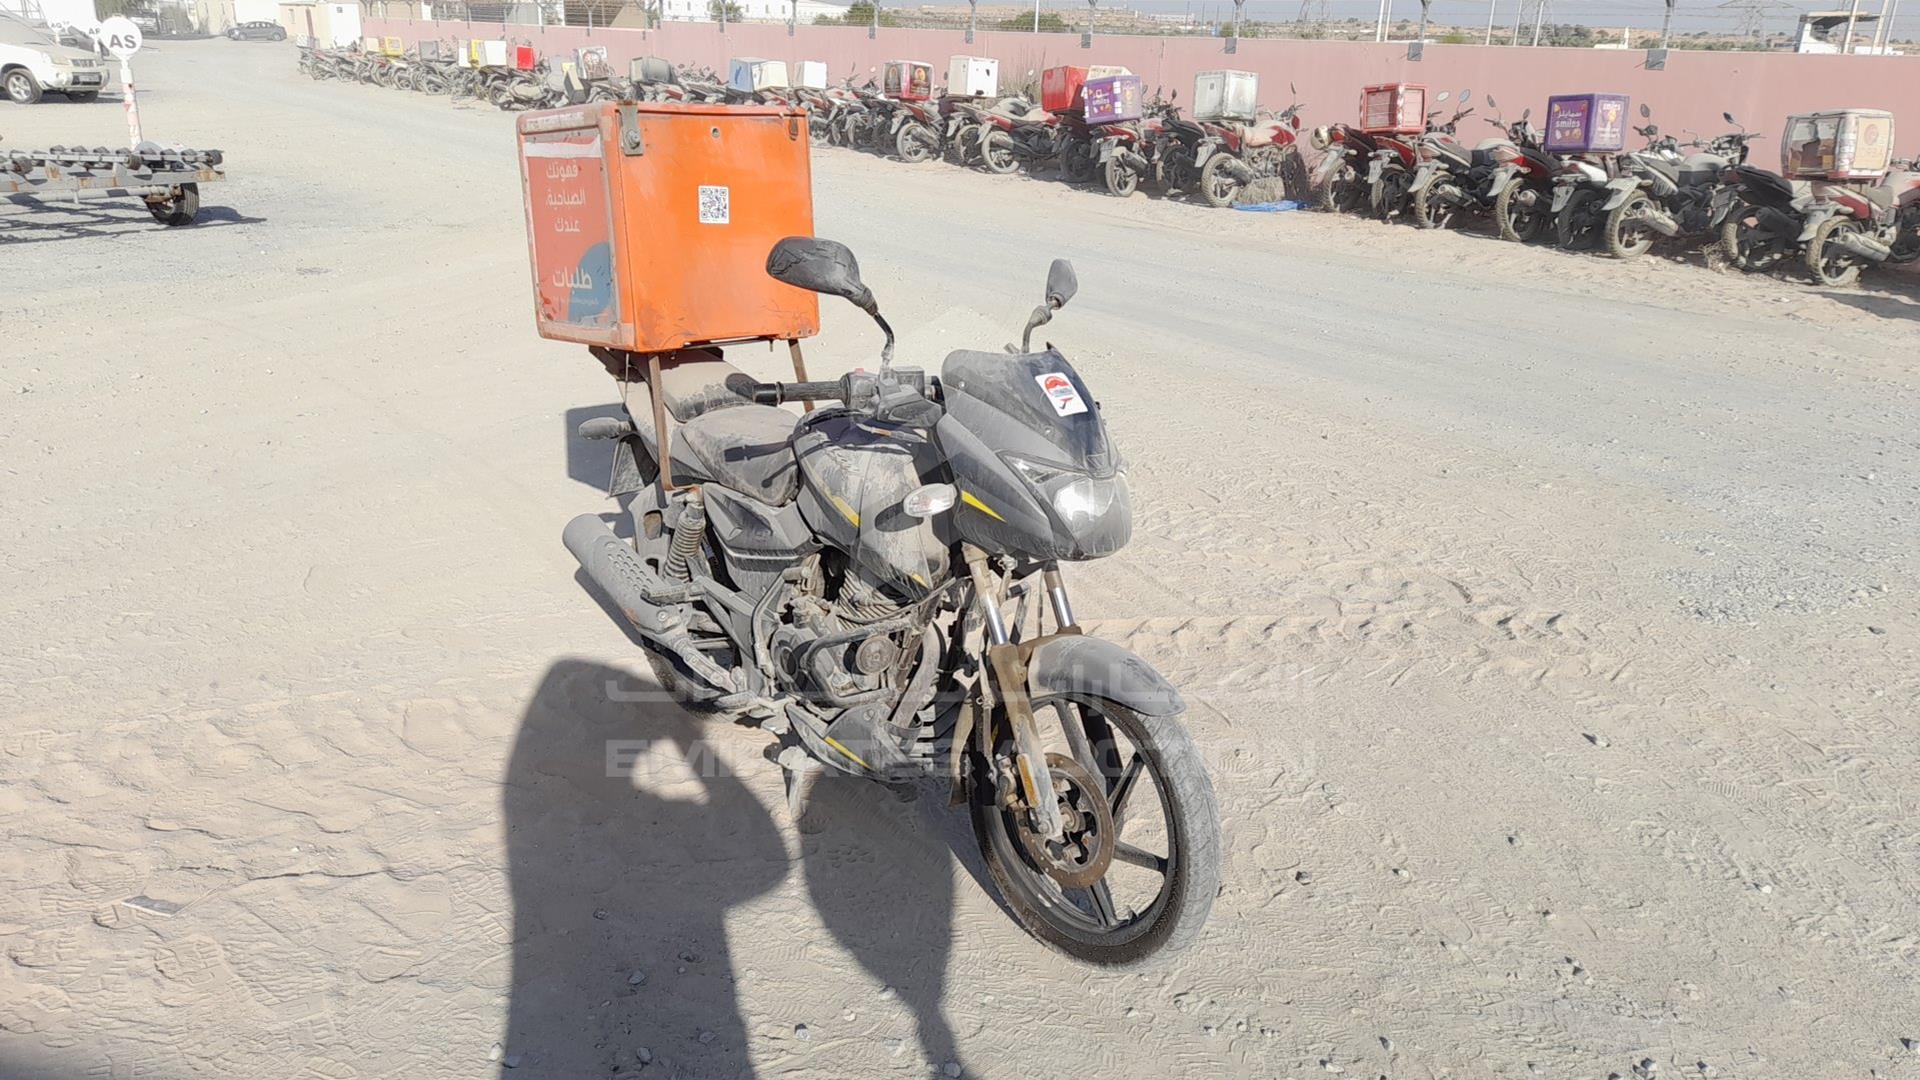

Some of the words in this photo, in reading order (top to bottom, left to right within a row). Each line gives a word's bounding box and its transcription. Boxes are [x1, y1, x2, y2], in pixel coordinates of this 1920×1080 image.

[109, 34, 137, 49] AS
[1555, 118, 1581, 128] smiles
[546, 159, 579, 182] قهوتك
[546, 188, 586, 211] الصباحية
[554, 217, 581, 233] عندك
[553, 266, 593, 295] طلبات
